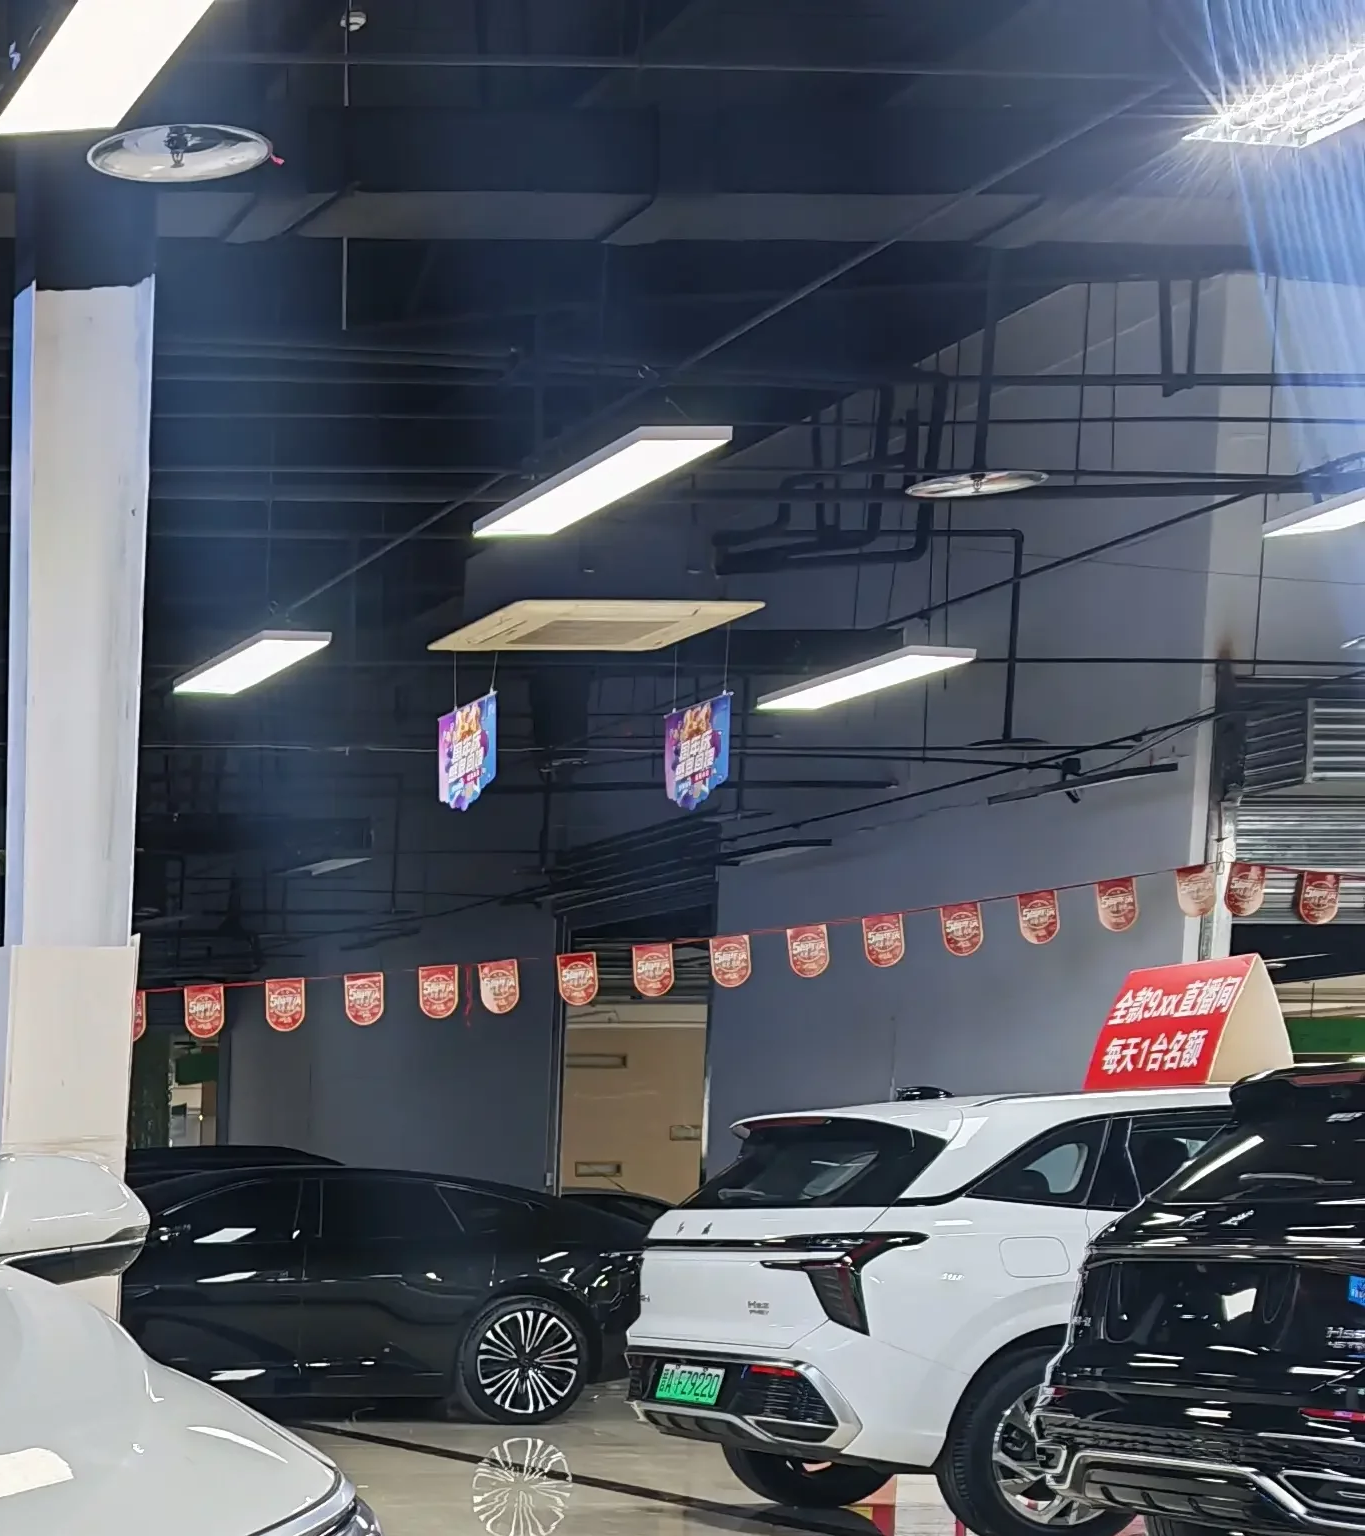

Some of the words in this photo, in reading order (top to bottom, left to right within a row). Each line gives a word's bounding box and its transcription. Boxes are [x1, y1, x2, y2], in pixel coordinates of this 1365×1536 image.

[1101, 1029, 1209, 1075] 每天1台名额
